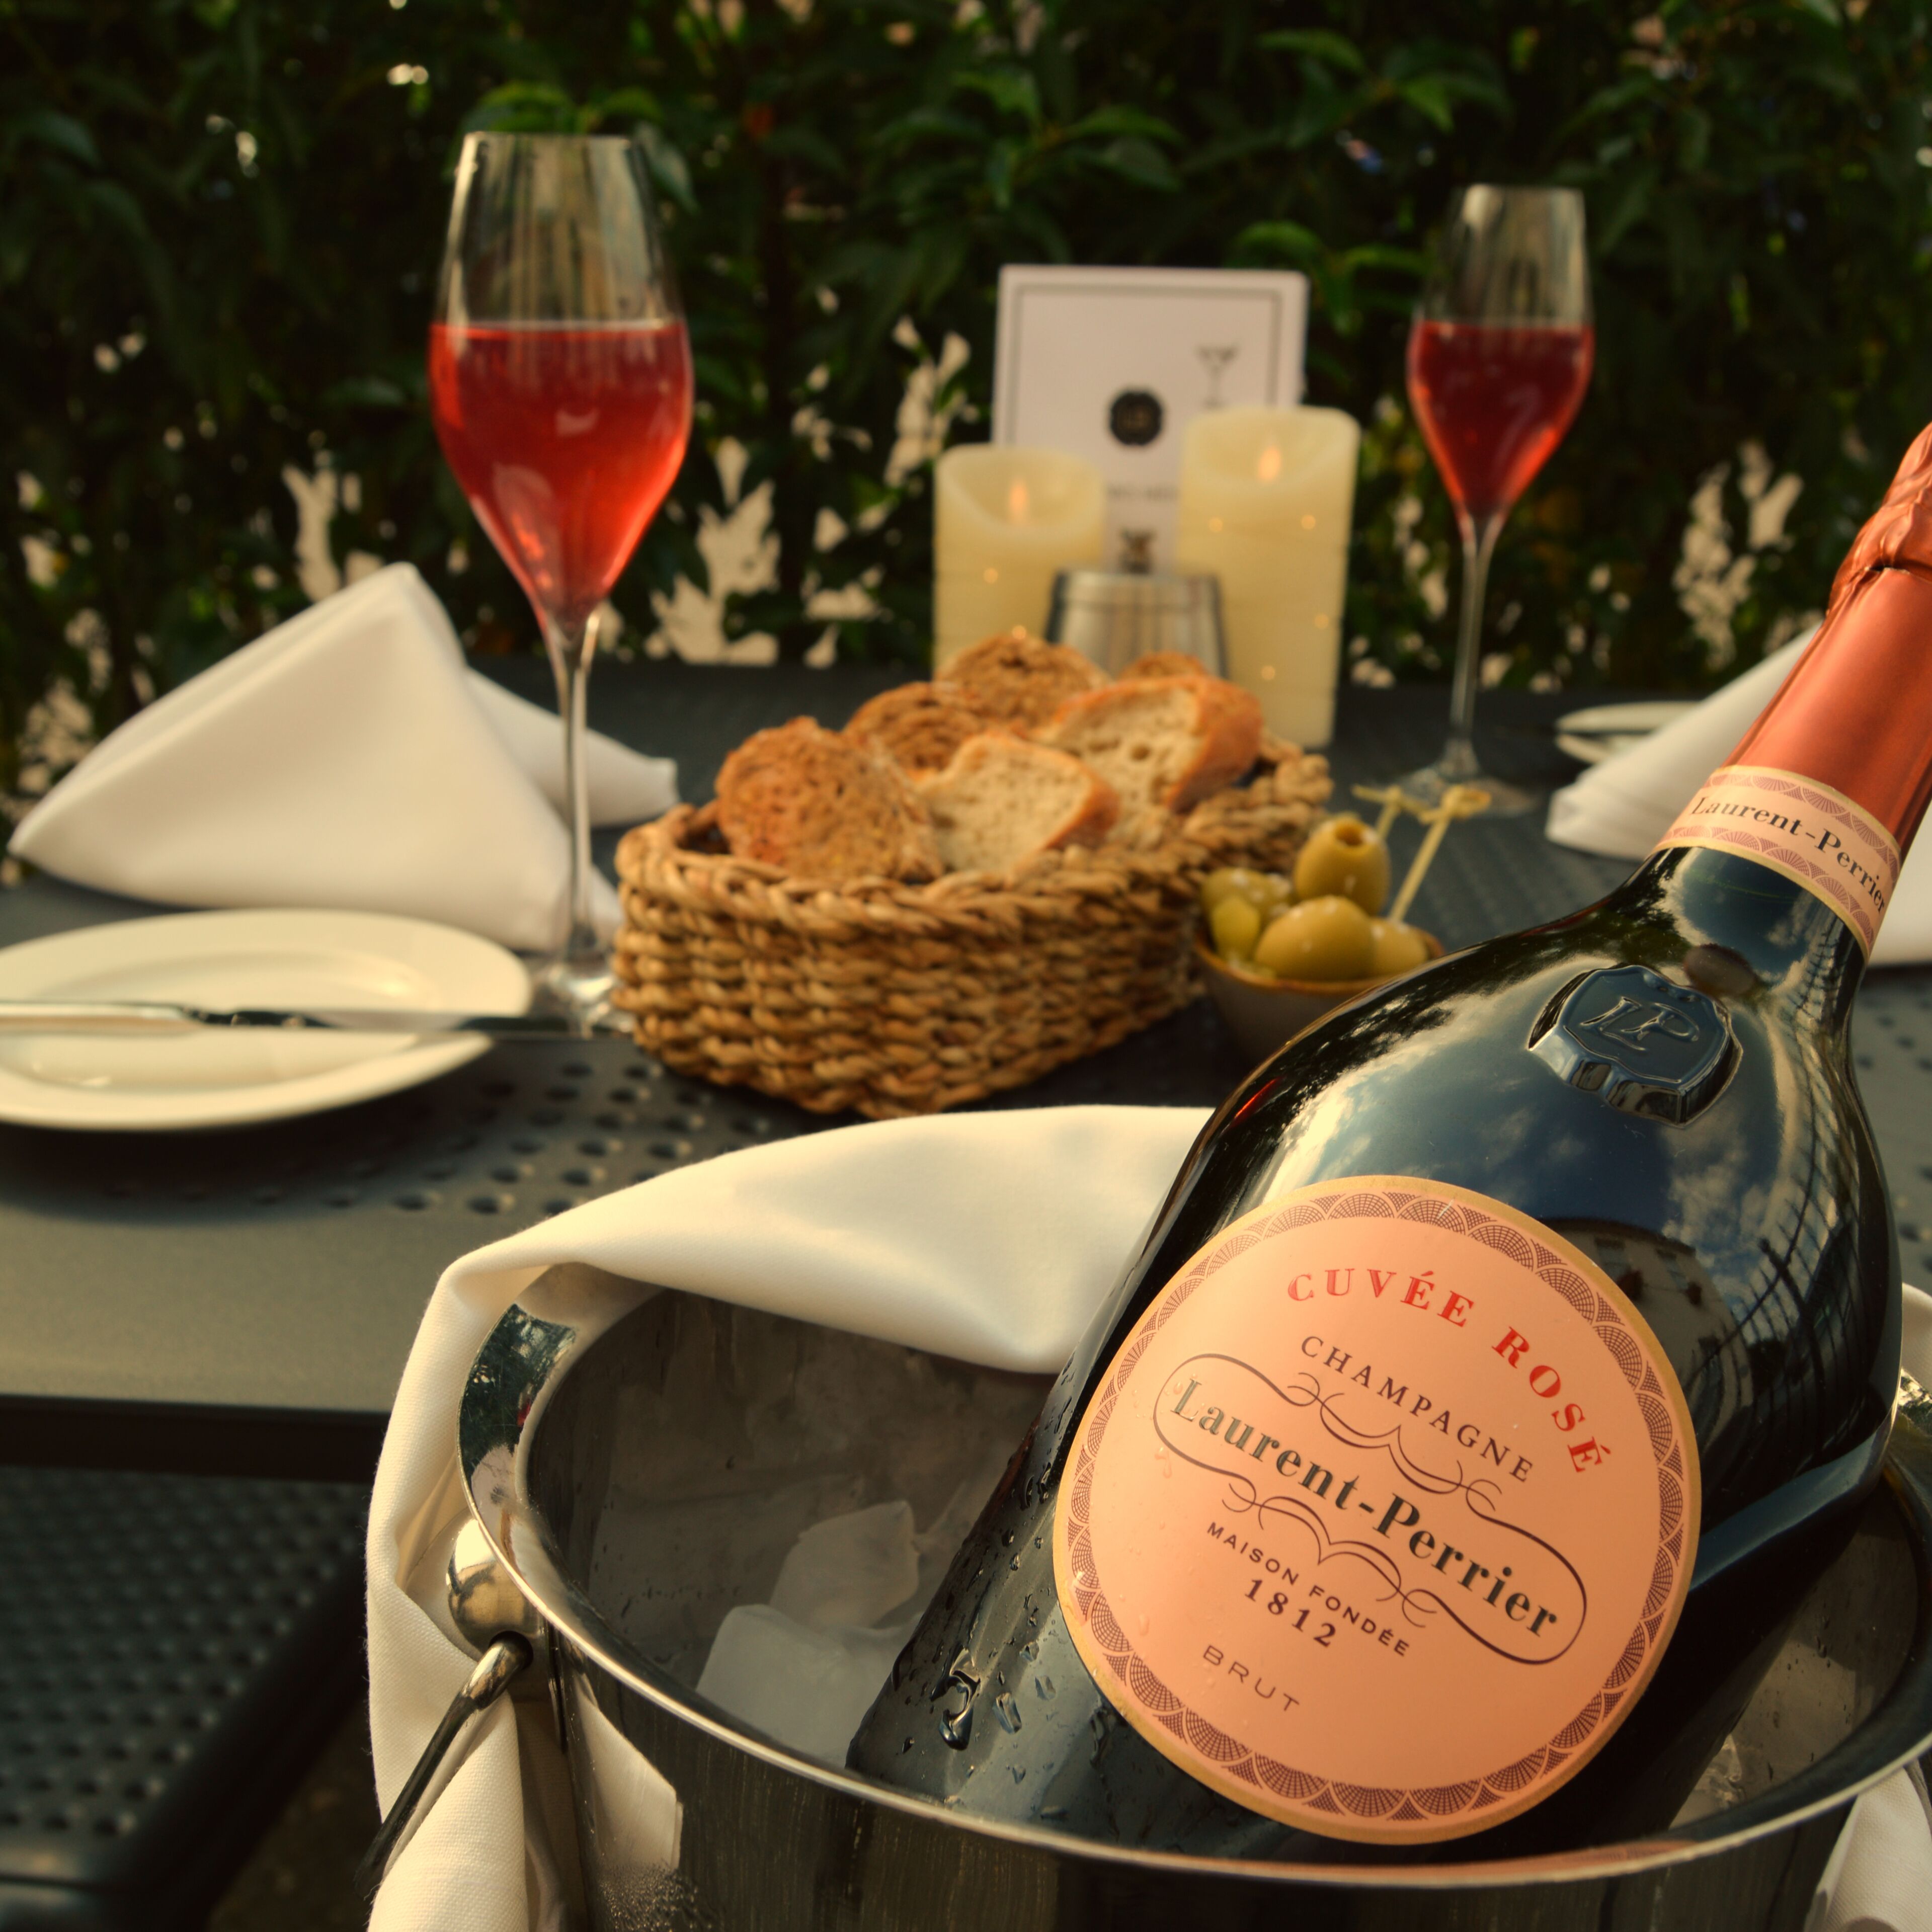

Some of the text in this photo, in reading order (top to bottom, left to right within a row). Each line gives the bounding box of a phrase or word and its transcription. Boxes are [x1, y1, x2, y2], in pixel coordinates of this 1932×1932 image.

[1690, 796, 1886, 914] Laurent-Perrier
[1287, 1269, 1611, 1473] CUVÉE ROSÉ
[1301, 1336, 1533, 1482] CHAMPAGNE
[1170, 1379, 1557, 1638] Laurent-Perrier
[1208, 1522, 1410, 1656] MAISON FONDÉE
[1244, 1578, 1337, 1647] 1812
[1202, 1644, 1300, 1711] BRUT
